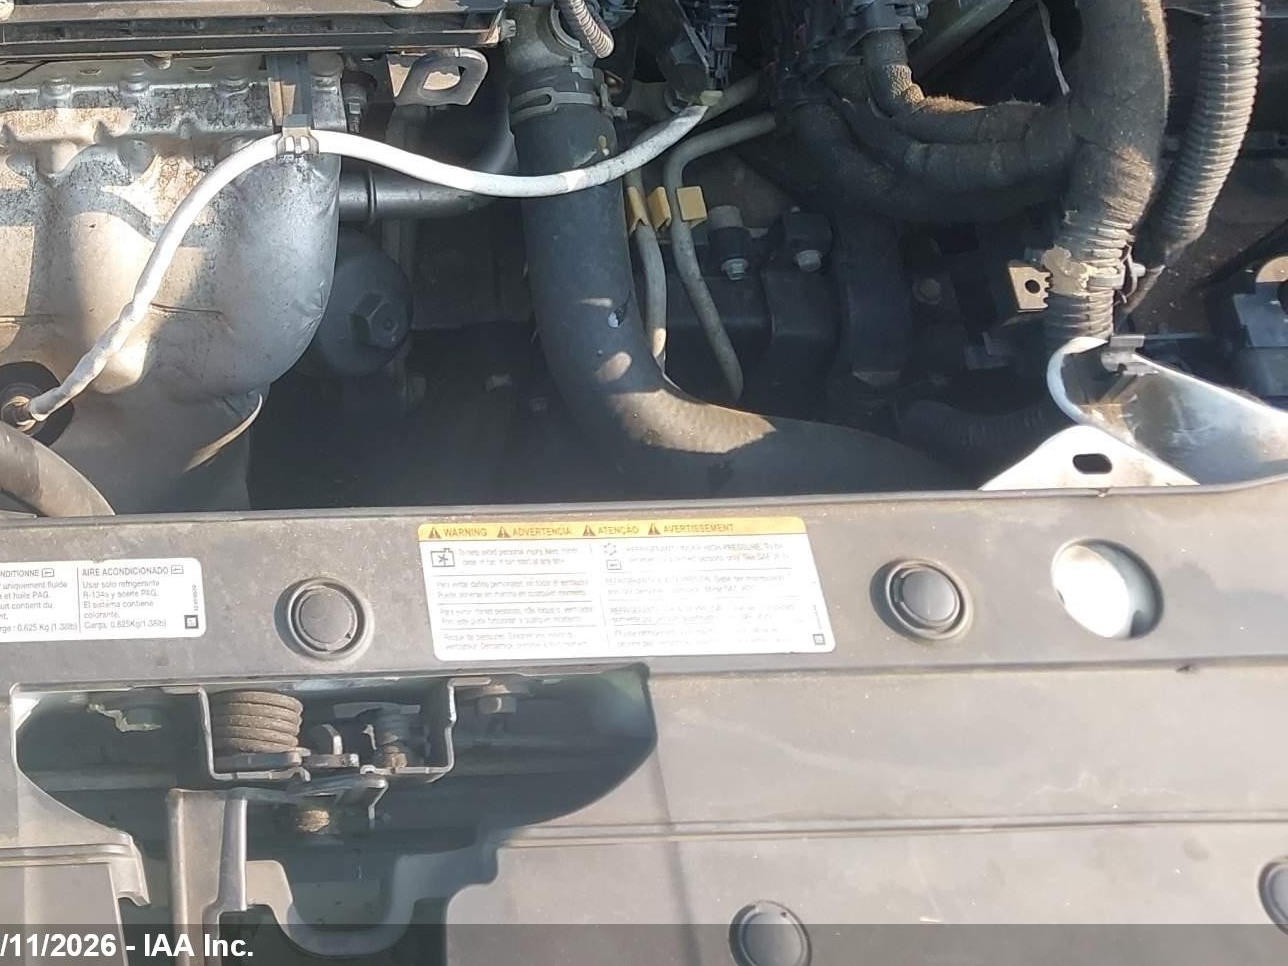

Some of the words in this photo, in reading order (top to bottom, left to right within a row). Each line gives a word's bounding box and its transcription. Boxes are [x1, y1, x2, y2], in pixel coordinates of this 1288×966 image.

[444, 527, 488, 538] WARNING
[512, 526, 572, 537] ADVERTENCIA
[663, 523, 734, 533] AVERTISSEMENT
[82, 568, 100, 576] AIRE
[102, 567, 168, 576] ACONDICIONADO
[3, 582, 46, 591] uniquement
[82, 581, 100, 589] Usar
[119, 580, 159, 588] refrigerante
[43, 601, 53, 609] du
[122, 600, 154, 608] contiene
[39, 624, 49, 632] Kg
